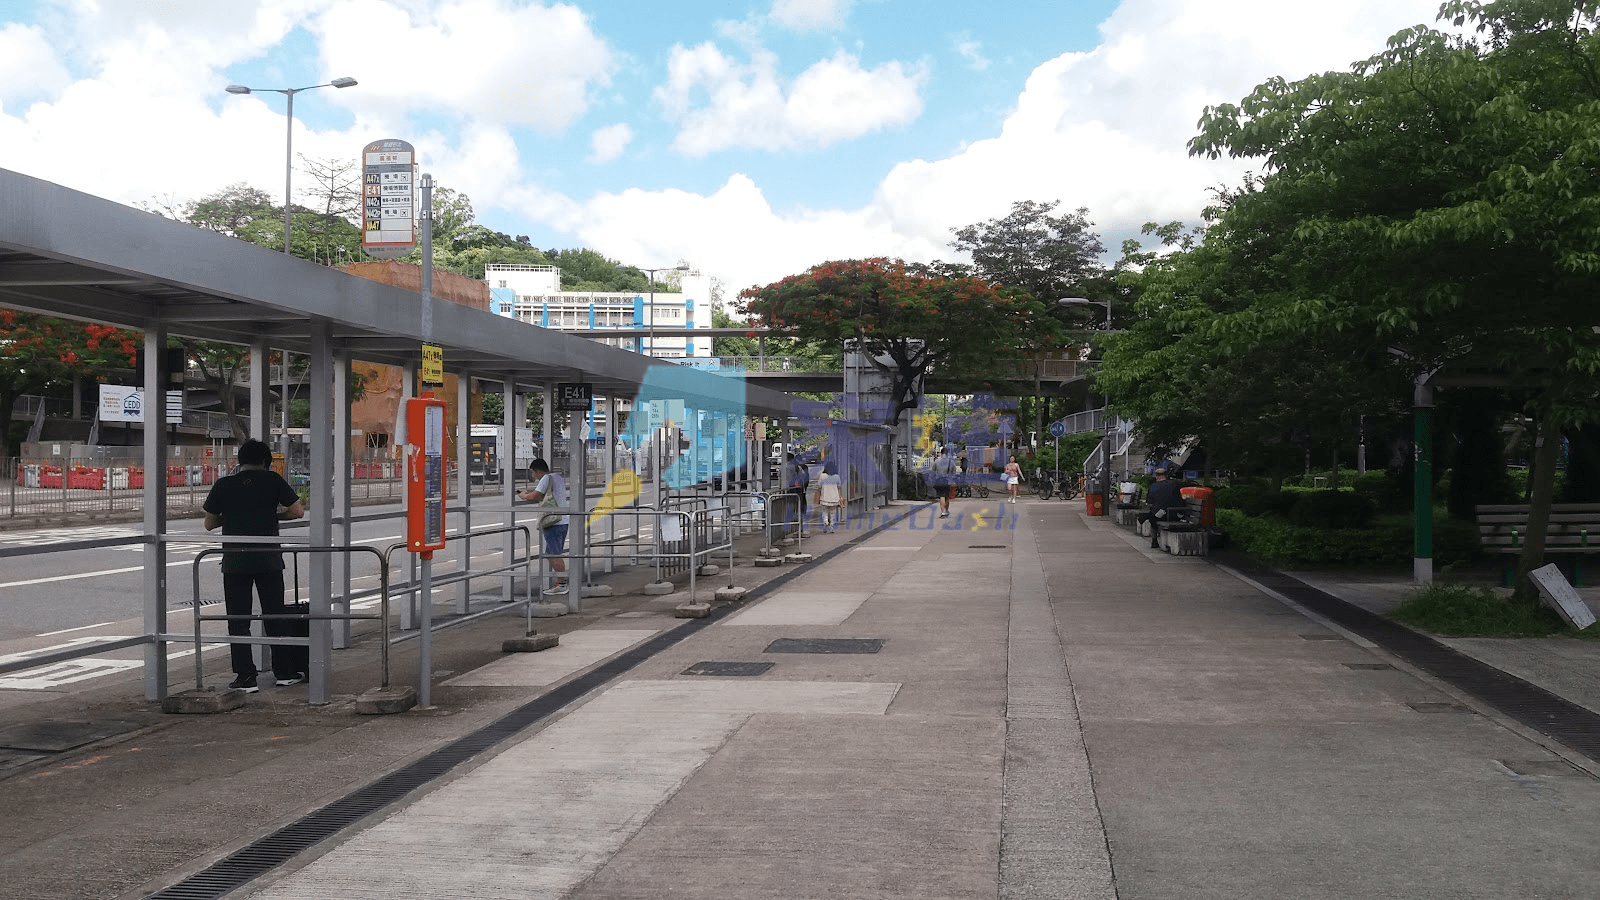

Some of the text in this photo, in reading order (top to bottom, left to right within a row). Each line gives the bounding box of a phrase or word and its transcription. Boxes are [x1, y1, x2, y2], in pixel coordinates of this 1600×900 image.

[367, 185, 380, 195] E41
[609, 296, 634, 304] SCHOOL
[564, 386, 585, 399] E41
[123, 400, 141, 410] CEDD
